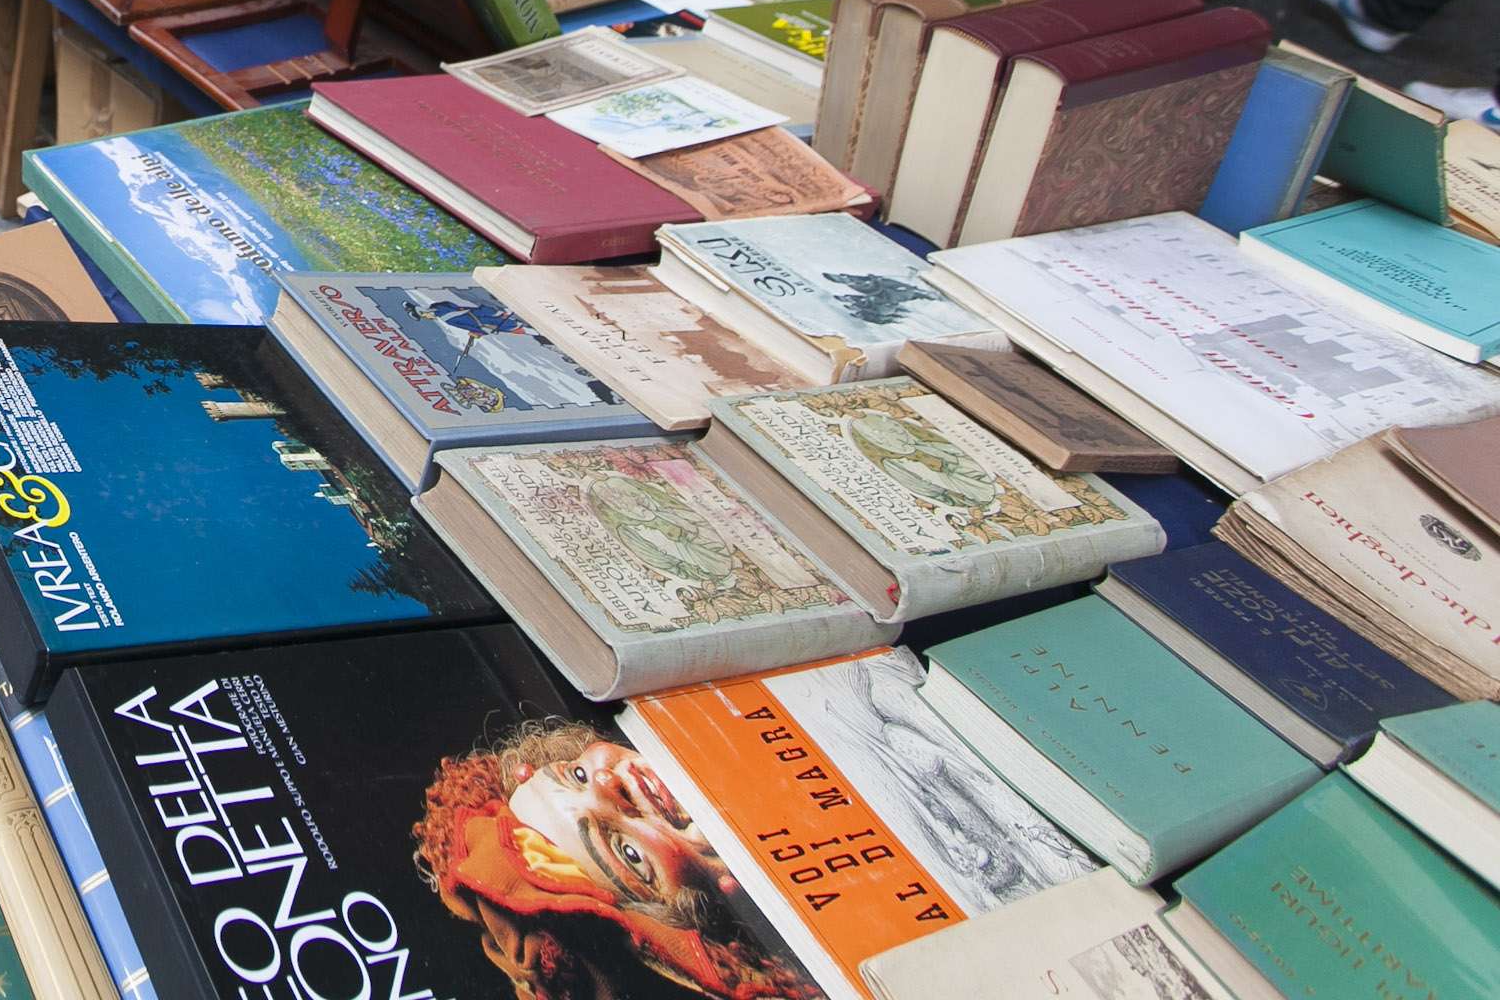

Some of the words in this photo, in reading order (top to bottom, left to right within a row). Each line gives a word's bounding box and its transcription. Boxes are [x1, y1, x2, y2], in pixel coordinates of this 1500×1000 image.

[689, 237, 804, 297] SKI
[371, 317, 417, 353] ALPI
[410, 356, 439, 376] LE
[768, 406, 839, 459] MONDE
[504, 463, 573, 524] MONDE
[849, 474, 933, 539] AUTOUR
[69, 531, 102, 582] ARGENTERO
[600, 534, 672, 601] DIRECTEUR
[1298, 489, 1427, 596] droghieri
[14, 516, 101, 632] IVREA
[83, 582, 97, 601] TEXT
[578, 540, 661, 616] AUTOUR
[1198, 570, 1280, 622] COZIE
[95, 582, 124, 627] ROLANDO
[95, 602, 111, 628] TESTO
[1429, 582, 1491, 646] due
[1279, 626, 1349, 670] ALPI
[219, 678, 233, 688] DI
[230, 677, 251, 704] CERRI
[241, 675, 254, 686] DI
[248, 689, 271, 719] TESTO
[251, 674, 291, 734] MESTURINO
[1008, 650, 1088, 715] ALPI
[227, 692, 267, 754] FOTOGRAFIE
[246, 707, 280, 757] MANUELA
[1028, 642, 1193, 774] PENNINE
[283, 736, 307, 765] GIAN
[744, 705, 852, 811] MAGRA
[114, 685, 245, 886] DELLA
[278, 769, 305, 806] SUPPO
[299, 809, 339, 869] RODOLFO
[810, 836, 859, 874] DI
[845, 828, 895, 864] DI
[758, 828, 840, 912] VOCI
